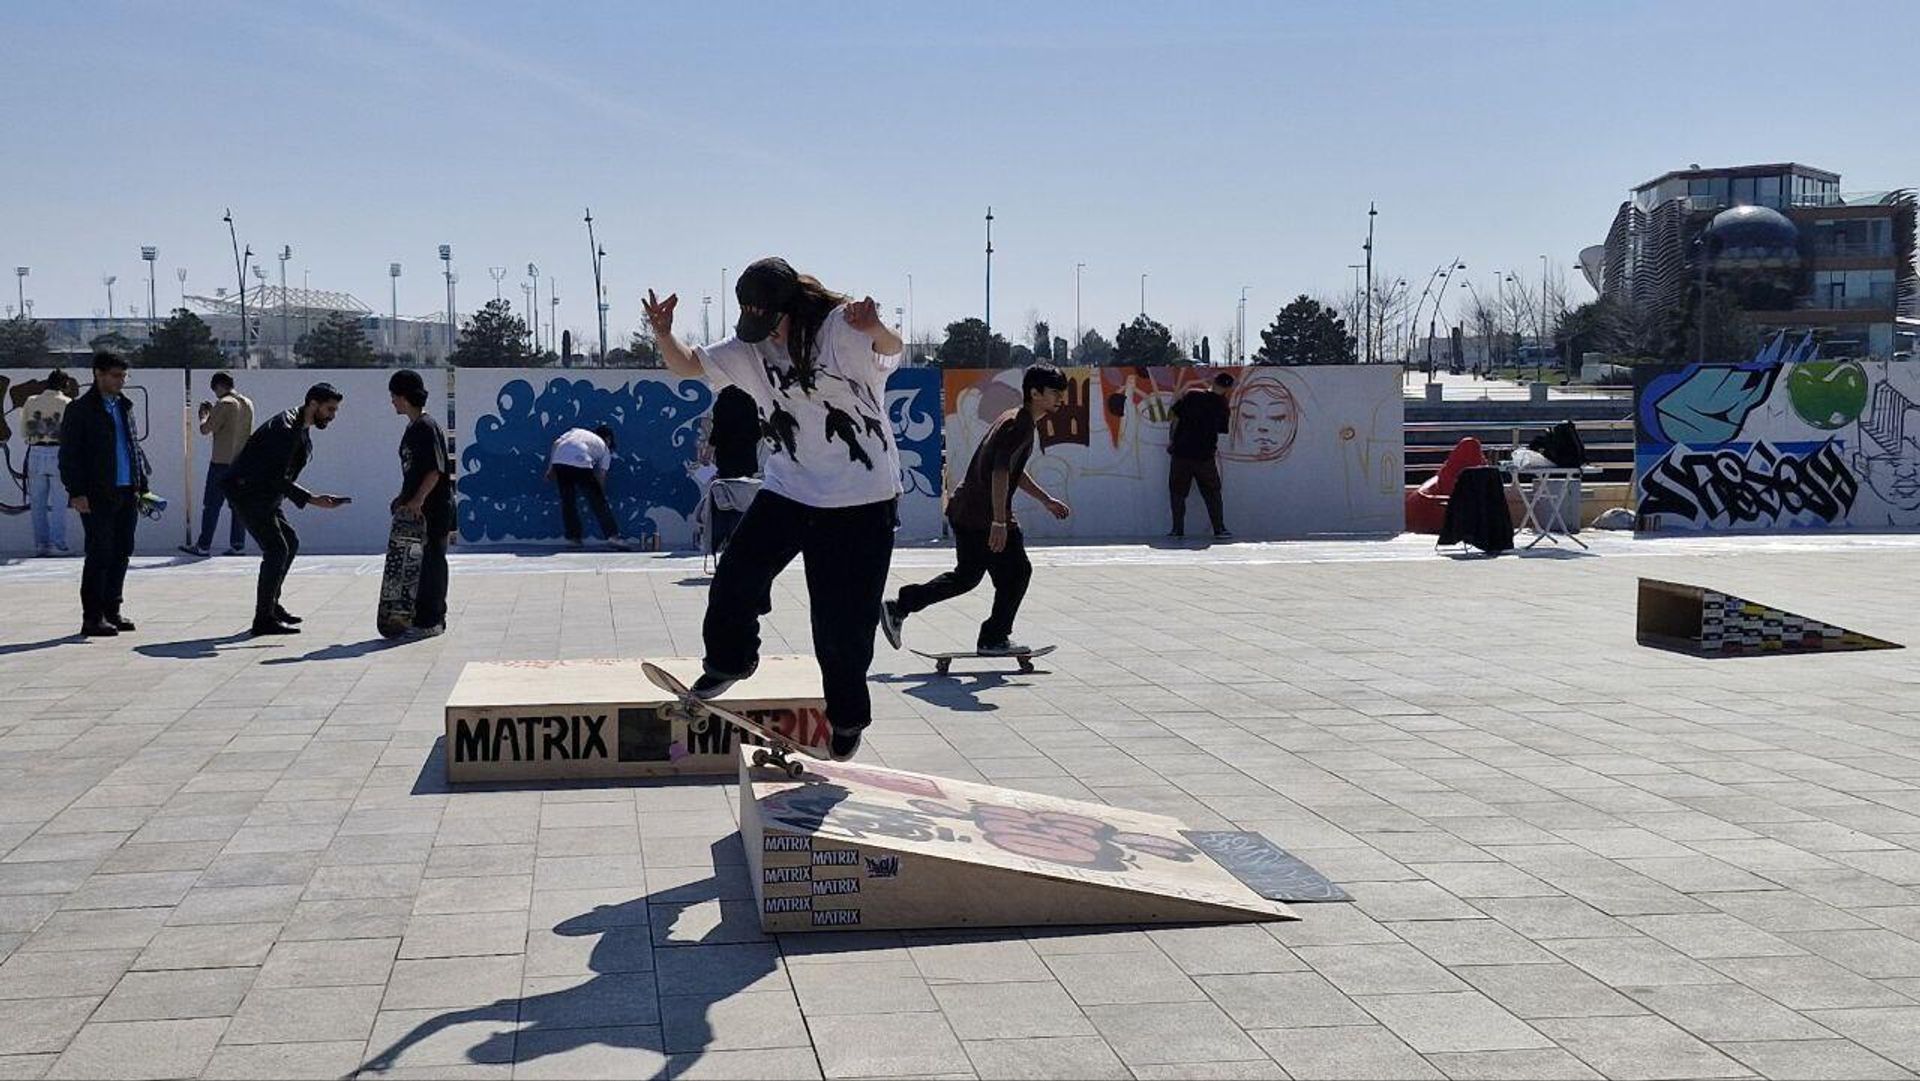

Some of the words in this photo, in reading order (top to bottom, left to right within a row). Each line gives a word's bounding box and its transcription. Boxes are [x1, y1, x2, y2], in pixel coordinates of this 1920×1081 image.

[455, 714, 608, 763] MATRIX
[764, 836, 811, 851] MATRIX
[812, 850, 859, 865] MATRIX
[764, 866, 812, 883] MATRIX
[813, 879, 859, 895] MATRIX
[765, 897, 811, 912] MATRIX
[813, 910, 859, 925] MATRIX
